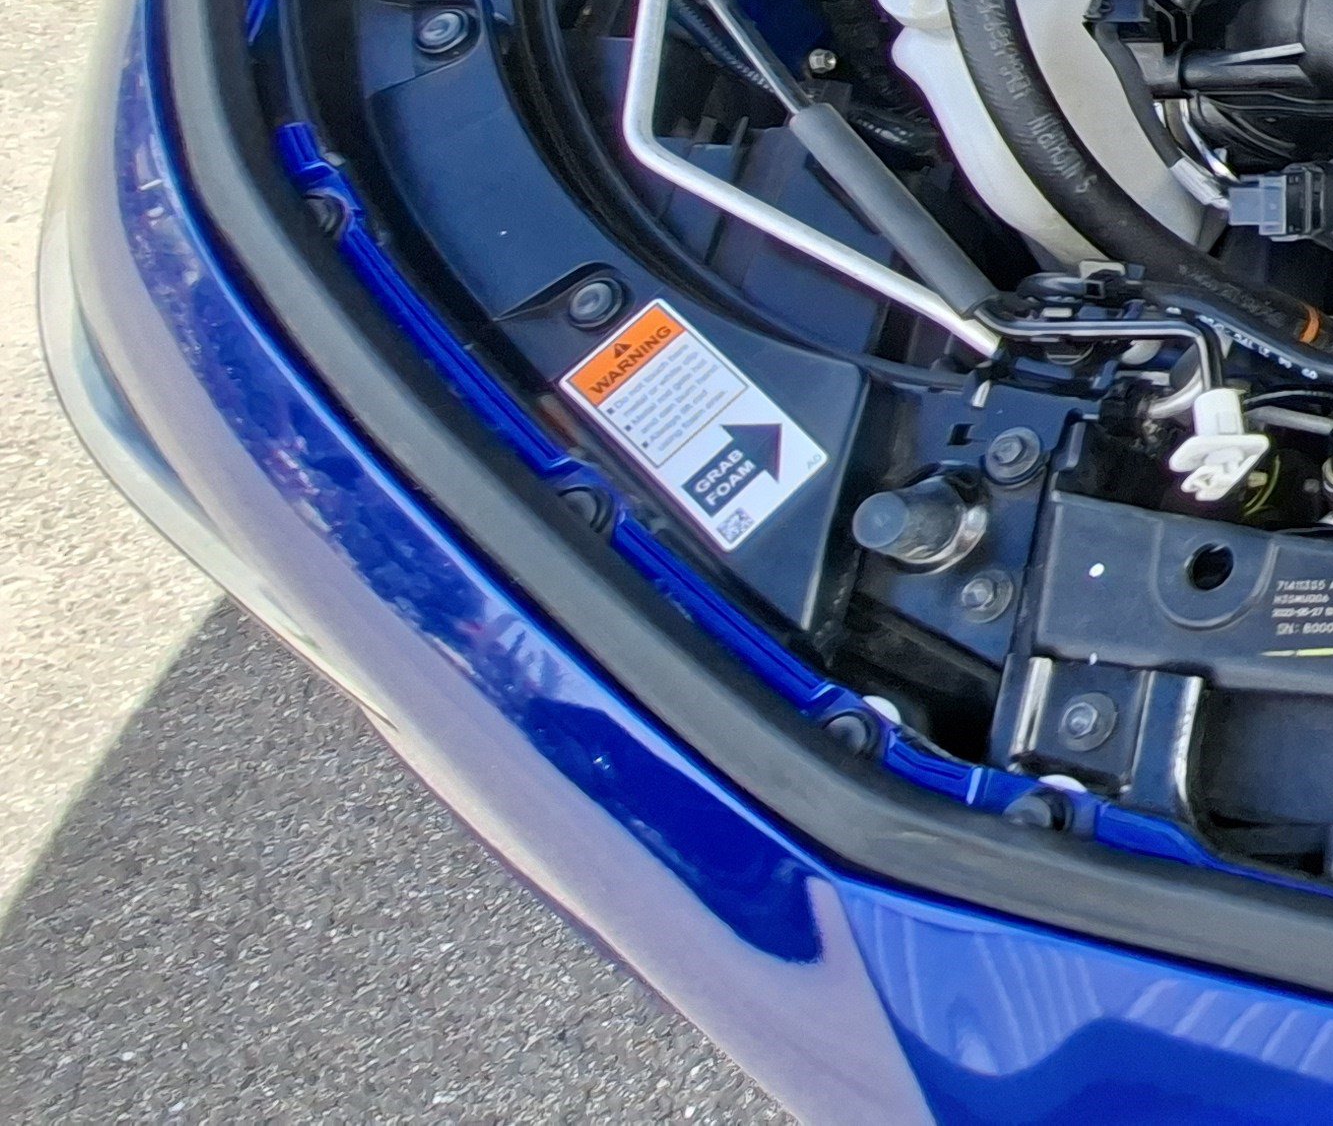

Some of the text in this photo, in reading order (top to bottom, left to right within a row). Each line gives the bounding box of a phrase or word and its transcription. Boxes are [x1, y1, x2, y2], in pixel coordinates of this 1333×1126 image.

[592, 325, 670, 394] WARNING
[694, 449, 744, 493] GRAB
[706, 461, 755, 504] FOAM
